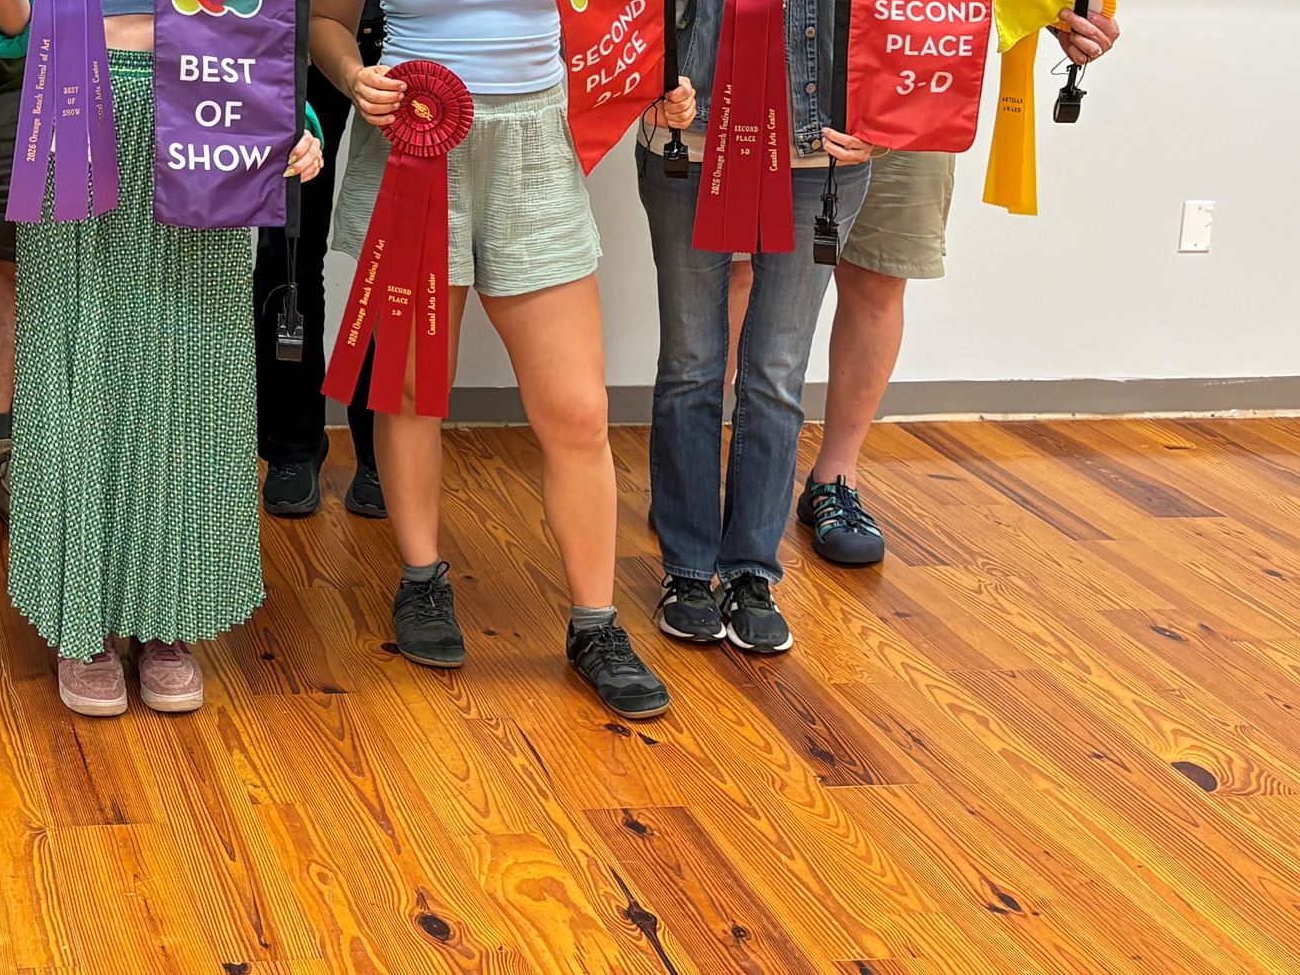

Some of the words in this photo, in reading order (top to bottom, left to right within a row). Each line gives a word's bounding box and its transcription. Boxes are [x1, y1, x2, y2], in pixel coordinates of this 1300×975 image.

[874, 0, 987, 23] SECOND
[41, 39, 50, 51] Art
[886, 33, 973, 57] PLACE
[40, 53, 49, 61] of
[586, 30, 647, 93] PLACE
[36, 65, 47, 90] Festival
[180, 55, 256, 84] BEST
[592, 72, 640, 108] 2-D
[896, 70, 953, 95] 3-D
[33, 93, 43, 114] Beach
[724, 97, 731, 105] of
[62, 109, 80, 117] SHOW
[195, 100, 243, 127] OF
[720, 107, 730, 130] Festival
[29, 118, 41, 143] Orange
[768, 132, 776, 145] Arts
[27, 144, 36, 162] 2026
[716, 133, 726, 152] Beach
[168, 142, 272, 171] SHOW
[713, 155, 725, 178] Orange
[768, 149, 777, 171] Coastal
[711, 178, 720, 195] 2026
[374, 251, 381, 259] of
[365, 261, 378, 284] Festival
[427, 273, 435, 293] Center
[359, 287, 372, 305] Beach
[387, 285, 412, 295] SECOND
[388, 295, 408, 305] PLACE
[428, 297, 436, 310] Arts
[352, 307, 366, 330] Orange
[427, 313, 435, 336] Coastal
[348, 329, 359, 347] 2026
